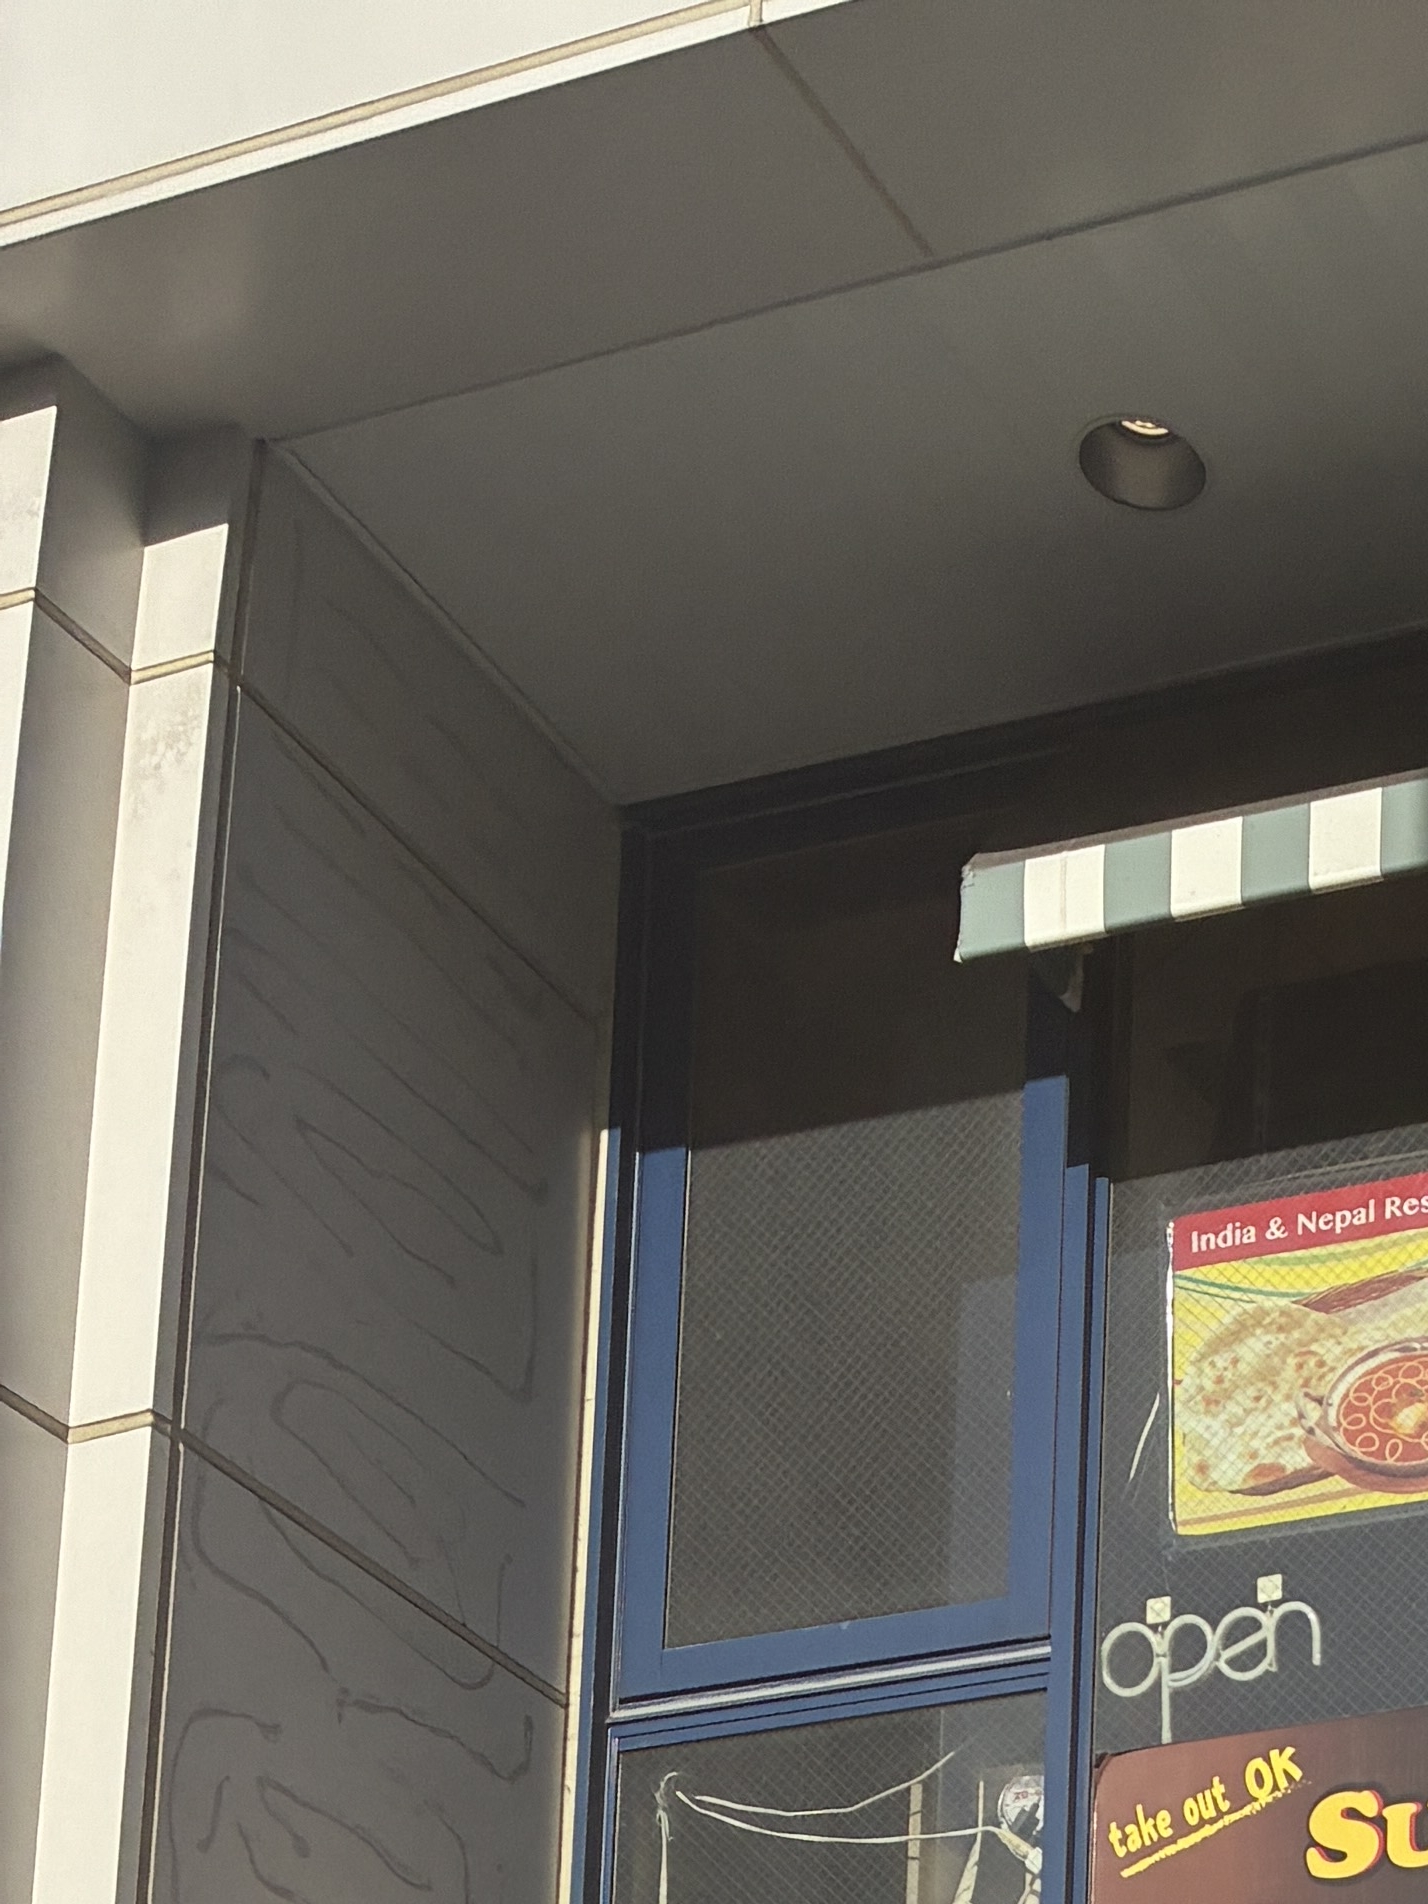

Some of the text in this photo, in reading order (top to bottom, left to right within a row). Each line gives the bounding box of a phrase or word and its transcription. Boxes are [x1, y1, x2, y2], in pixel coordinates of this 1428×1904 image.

[1191, 1221, 1256, 1253] India
[1265, 1216, 1289, 1240] &
[1297, 1198, 1376, 1238] Nepal
[1101, 1600, 1321, 1744] open
[1107, 1745, 1304, 1859] take out OK
